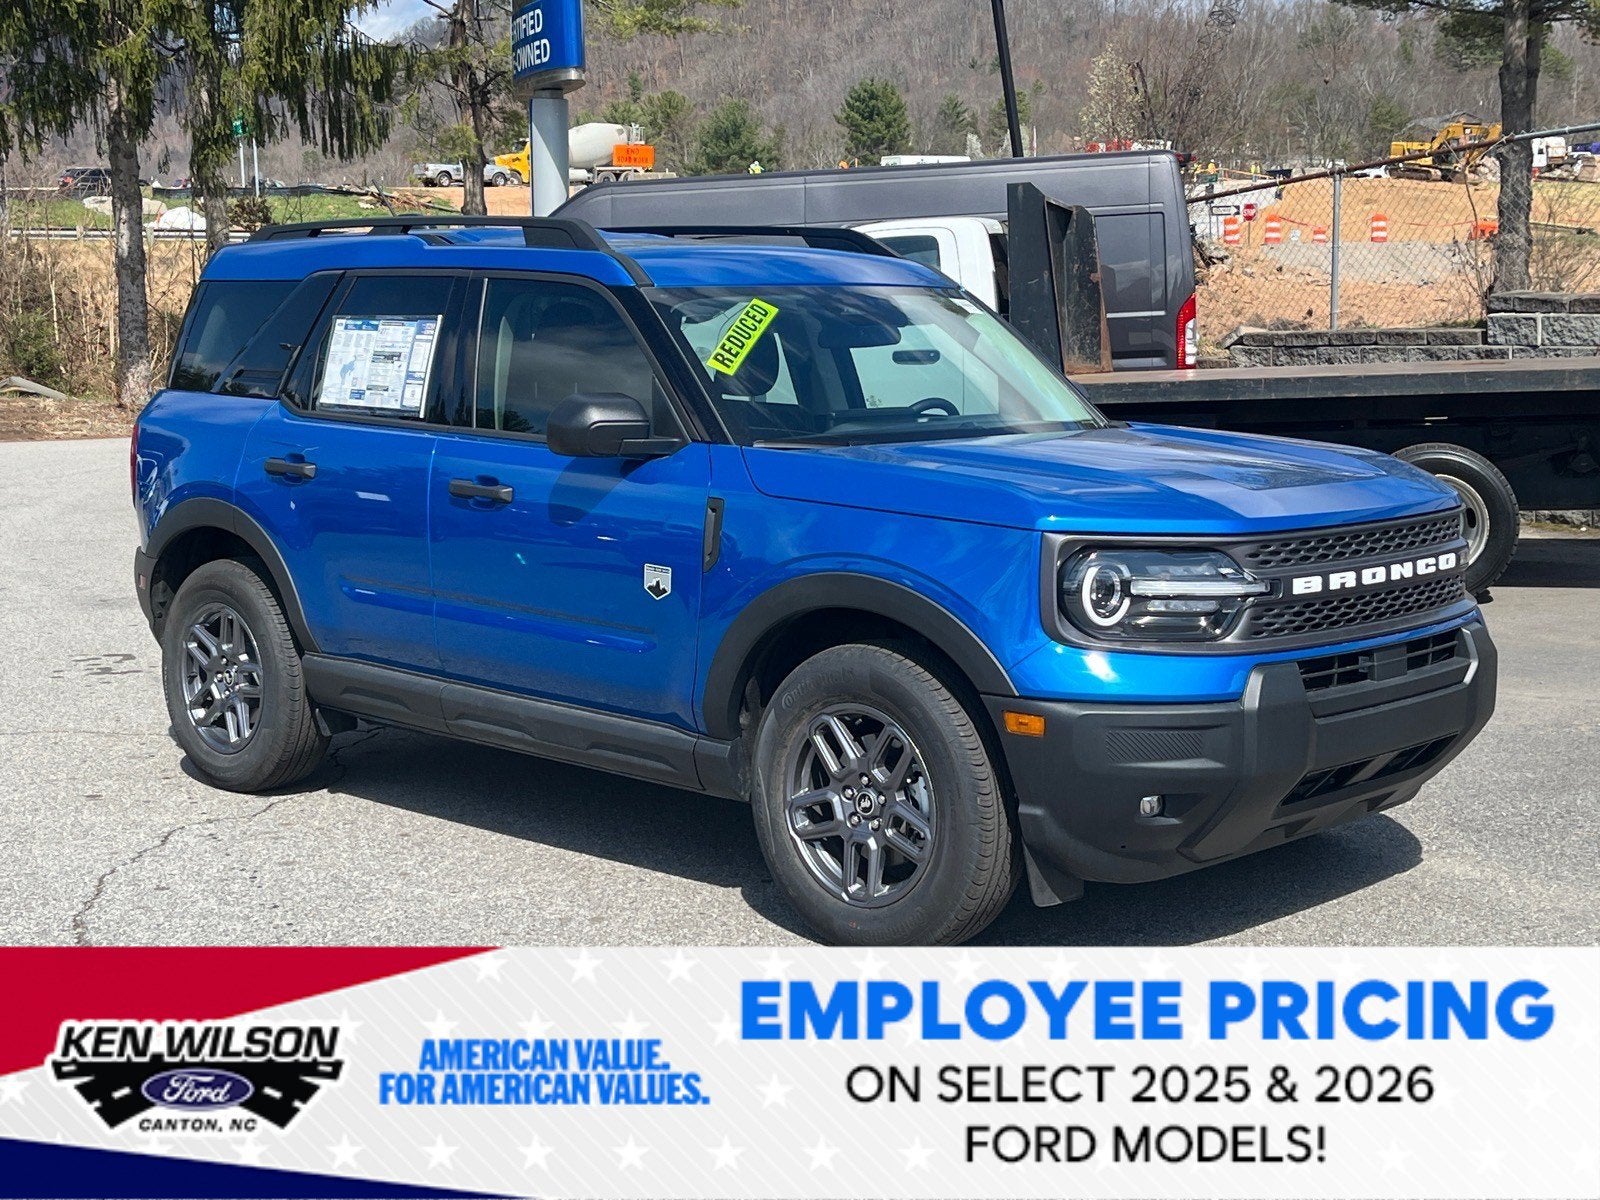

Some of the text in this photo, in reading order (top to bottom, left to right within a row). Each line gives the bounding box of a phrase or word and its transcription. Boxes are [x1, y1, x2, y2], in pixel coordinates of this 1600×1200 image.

[513, 38, 551, 74] -OWNED
[702, 303, 770, 369] REDUCED
[1292, 552, 1456, 595] BRONCO
